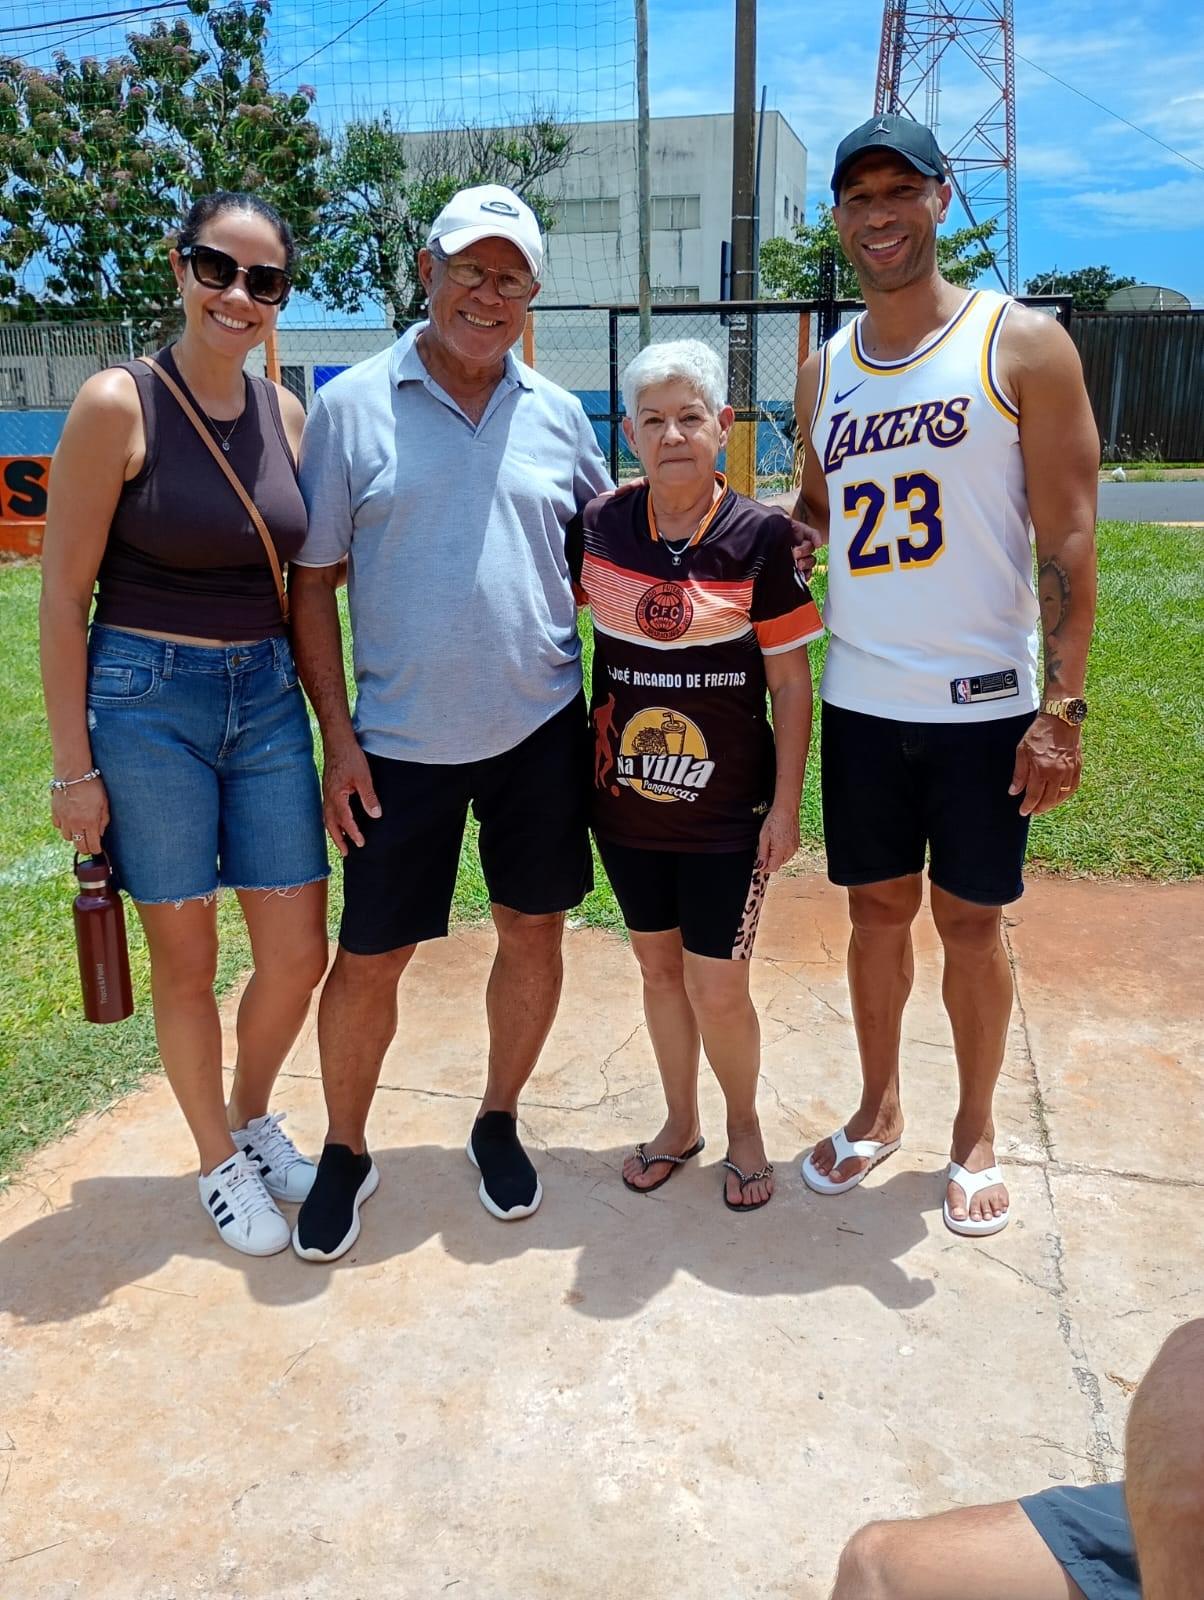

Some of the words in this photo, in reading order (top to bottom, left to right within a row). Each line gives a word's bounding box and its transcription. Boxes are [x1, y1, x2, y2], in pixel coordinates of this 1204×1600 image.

[824, 397, 971, 475] LAKERS
[0, 460, 48, 517] S
[843, 469, 946, 577] 23
[649, 604, 680, 620] CFC
[633, 671, 682, 688] RICARDO
[686, 673, 701, 688] DE
[704, 671, 747, 688] FREITAS
[616, 755, 634, 776] Na
[642, 754, 715, 789] Villa
[643, 779, 699, 802] Panquecas
